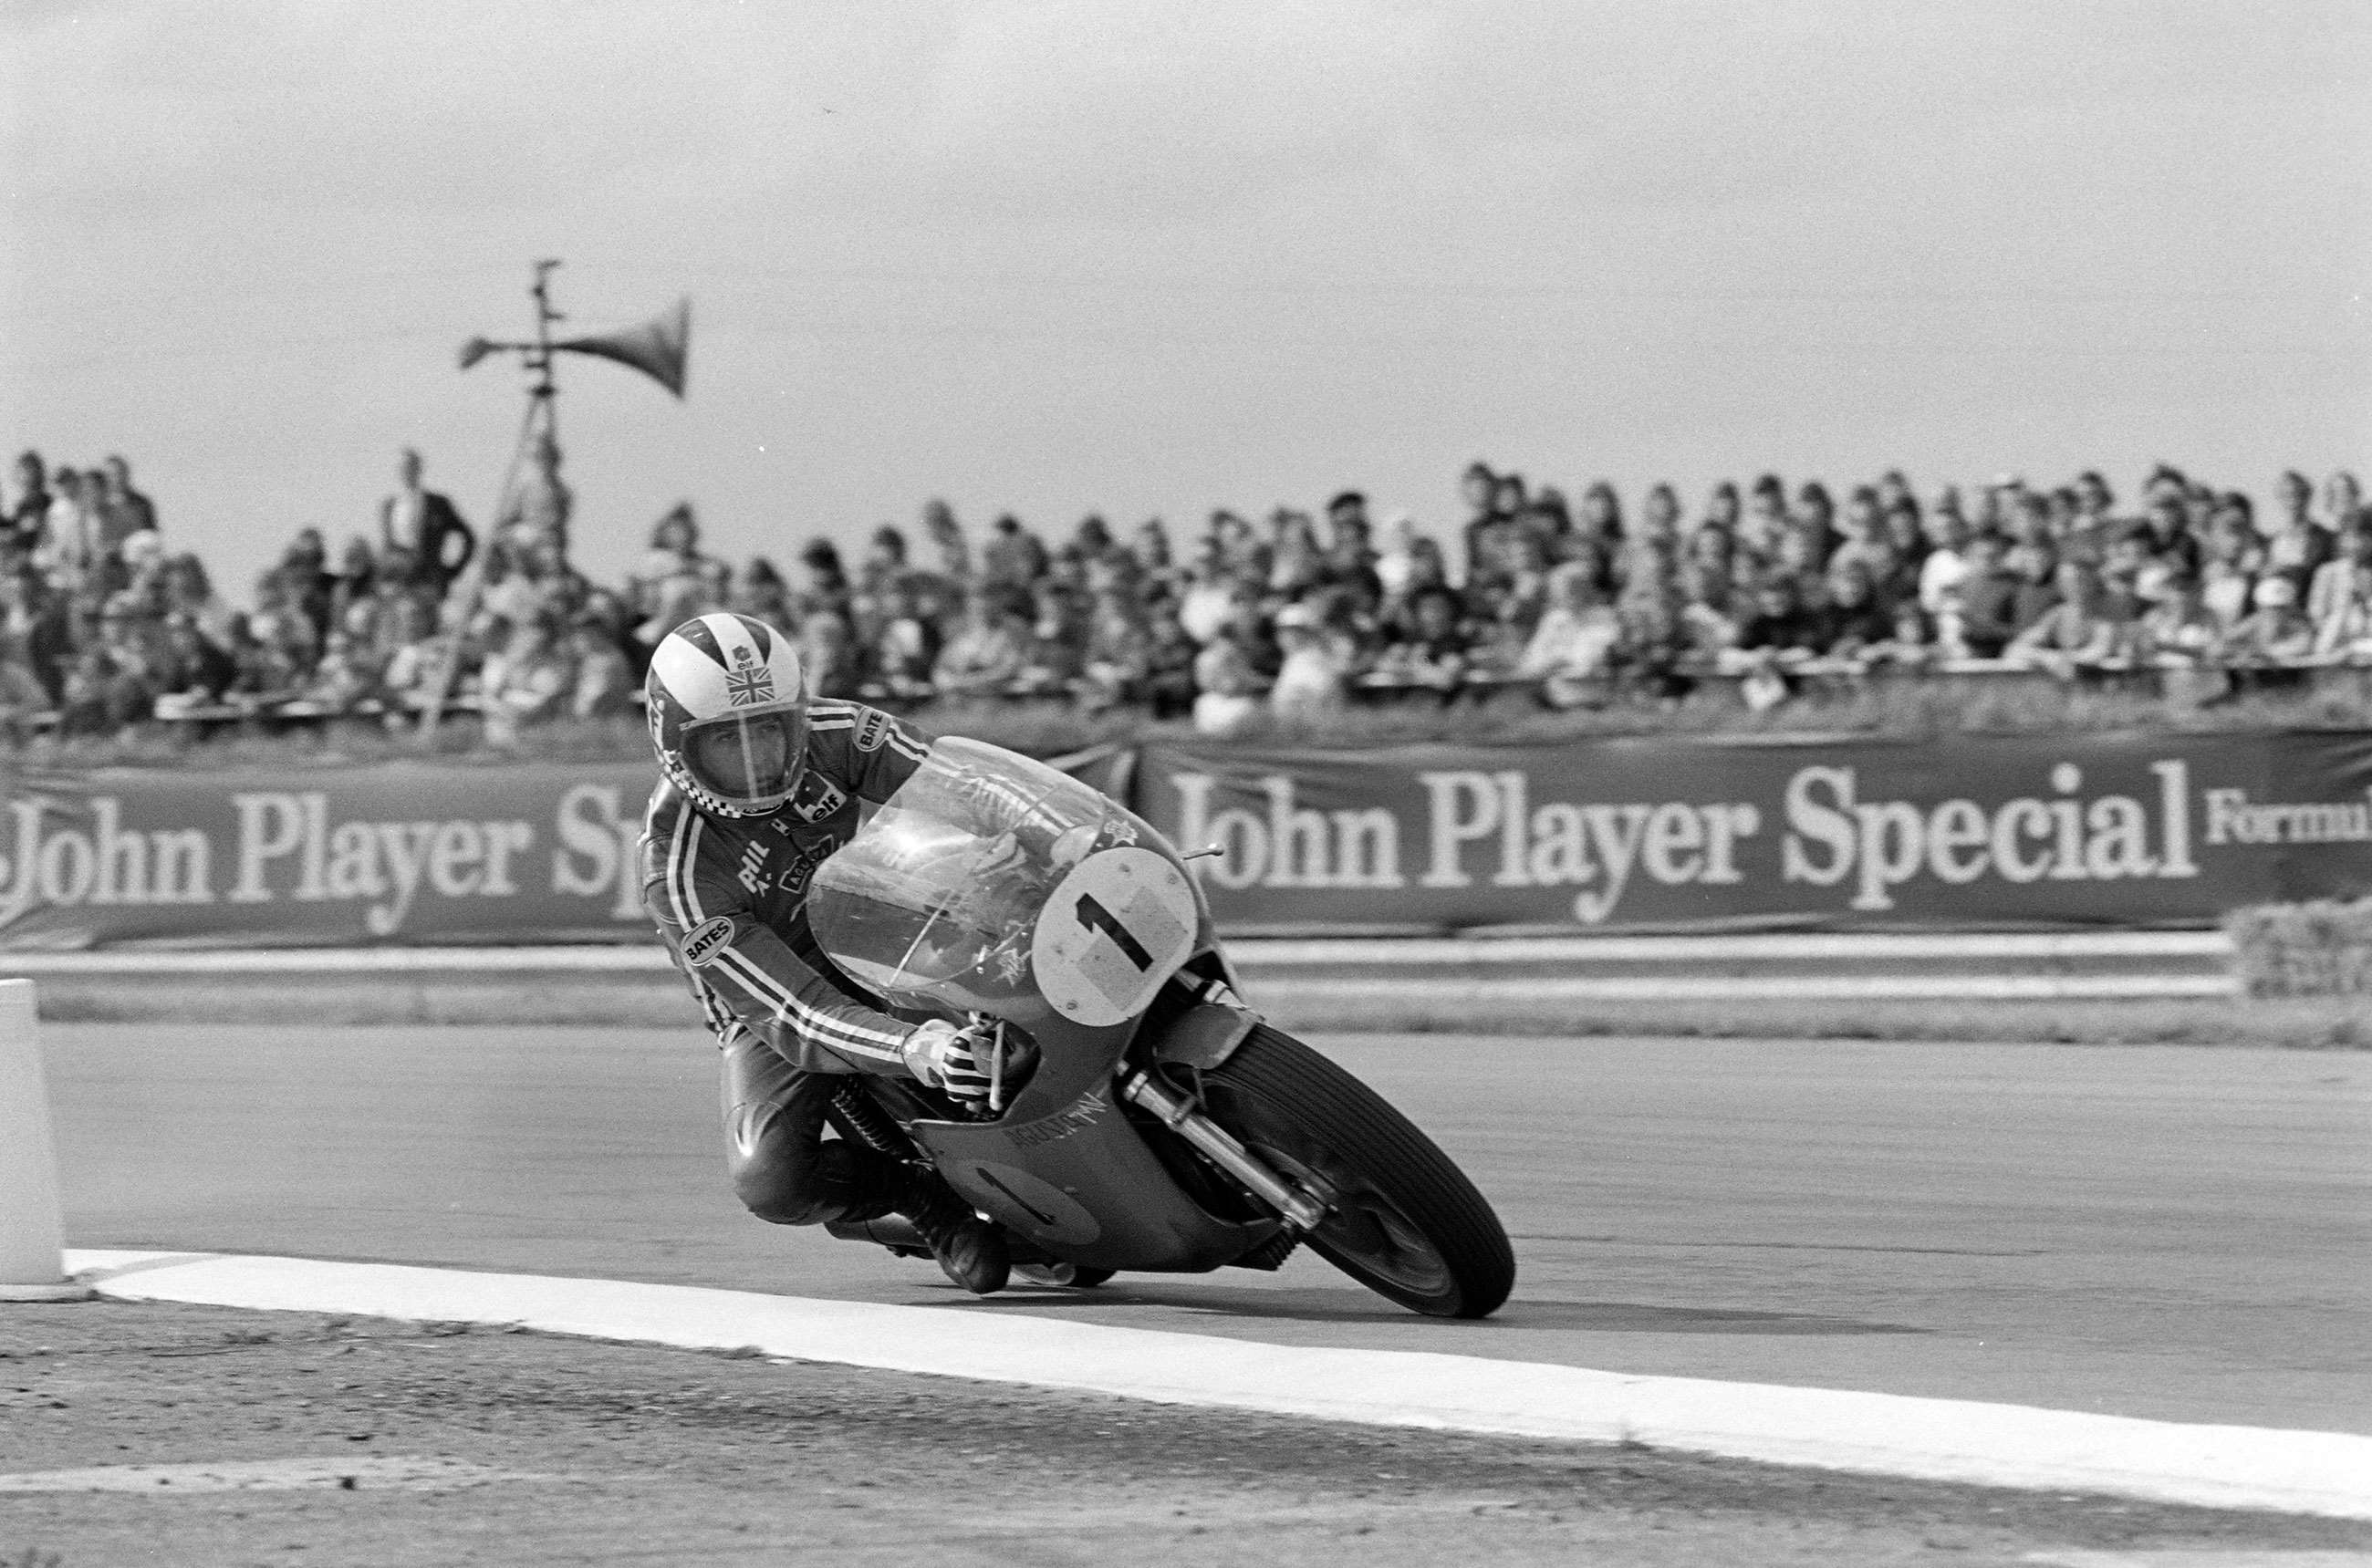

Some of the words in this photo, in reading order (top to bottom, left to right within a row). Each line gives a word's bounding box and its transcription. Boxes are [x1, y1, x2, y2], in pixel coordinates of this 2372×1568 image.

[859, 712, 884, 746] BATE
[811, 794, 840, 820] elf
[0, 796, 214, 926] John
[232, 792, 535, 936] Player
[737, 840, 771, 894] PHIL
[1171, 772, 1406, 889] John
[1420, 770, 1761, 923] Player
[1782, 759, 2200, 911] Special
[685, 921, 730, 960] BATES
[1076, 892, 1154, 973] 1
